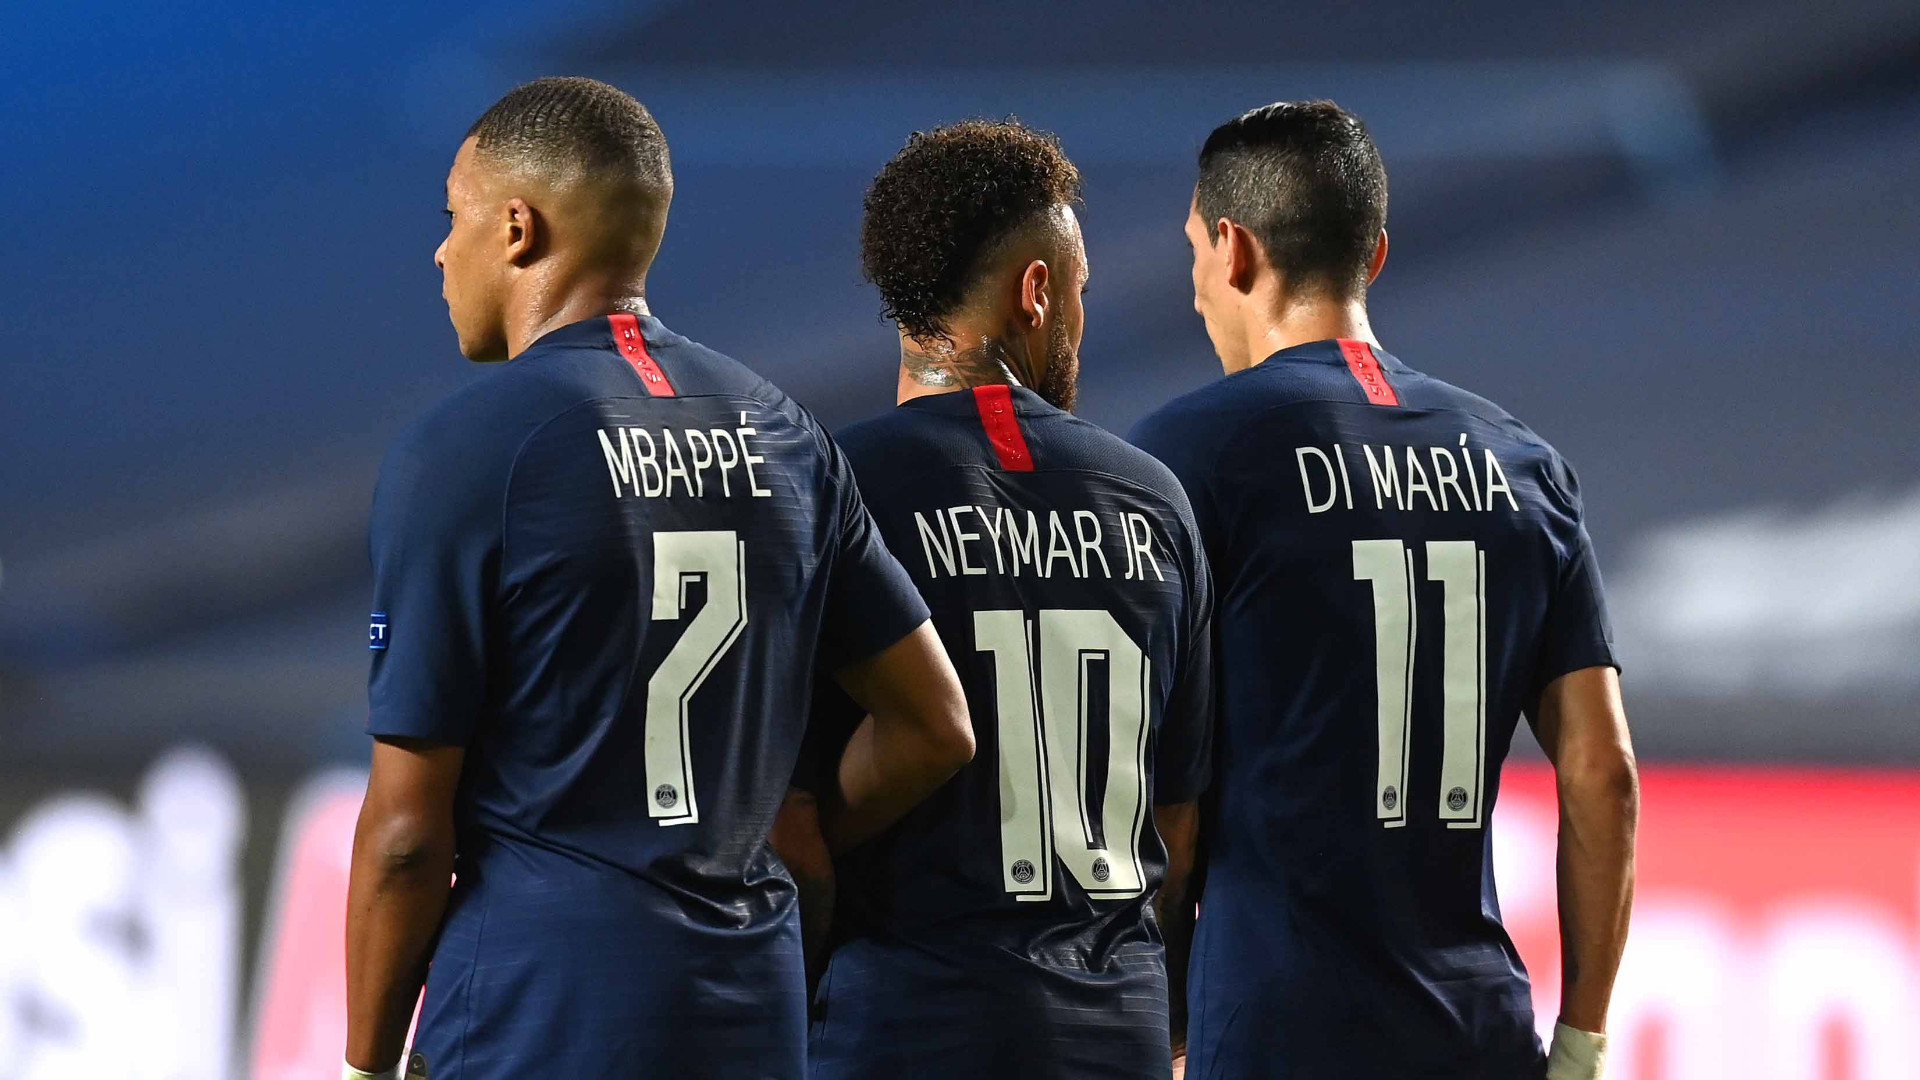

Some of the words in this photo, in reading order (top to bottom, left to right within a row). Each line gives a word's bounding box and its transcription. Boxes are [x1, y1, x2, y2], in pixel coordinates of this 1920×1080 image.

[597, 411, 772, 498] MBAPPÉ
[914, 505, 1112, 579] NEYMAR
[1119, 511, 1165, 581] JR
[1295, 444, 1353, 513] DI
[1362, 433, 1519, 512] MARÍA
[645, 530, 748, 827] 7
[973, 609, 1151, 901] 10
[1351, 539, 1486, 829] 11
